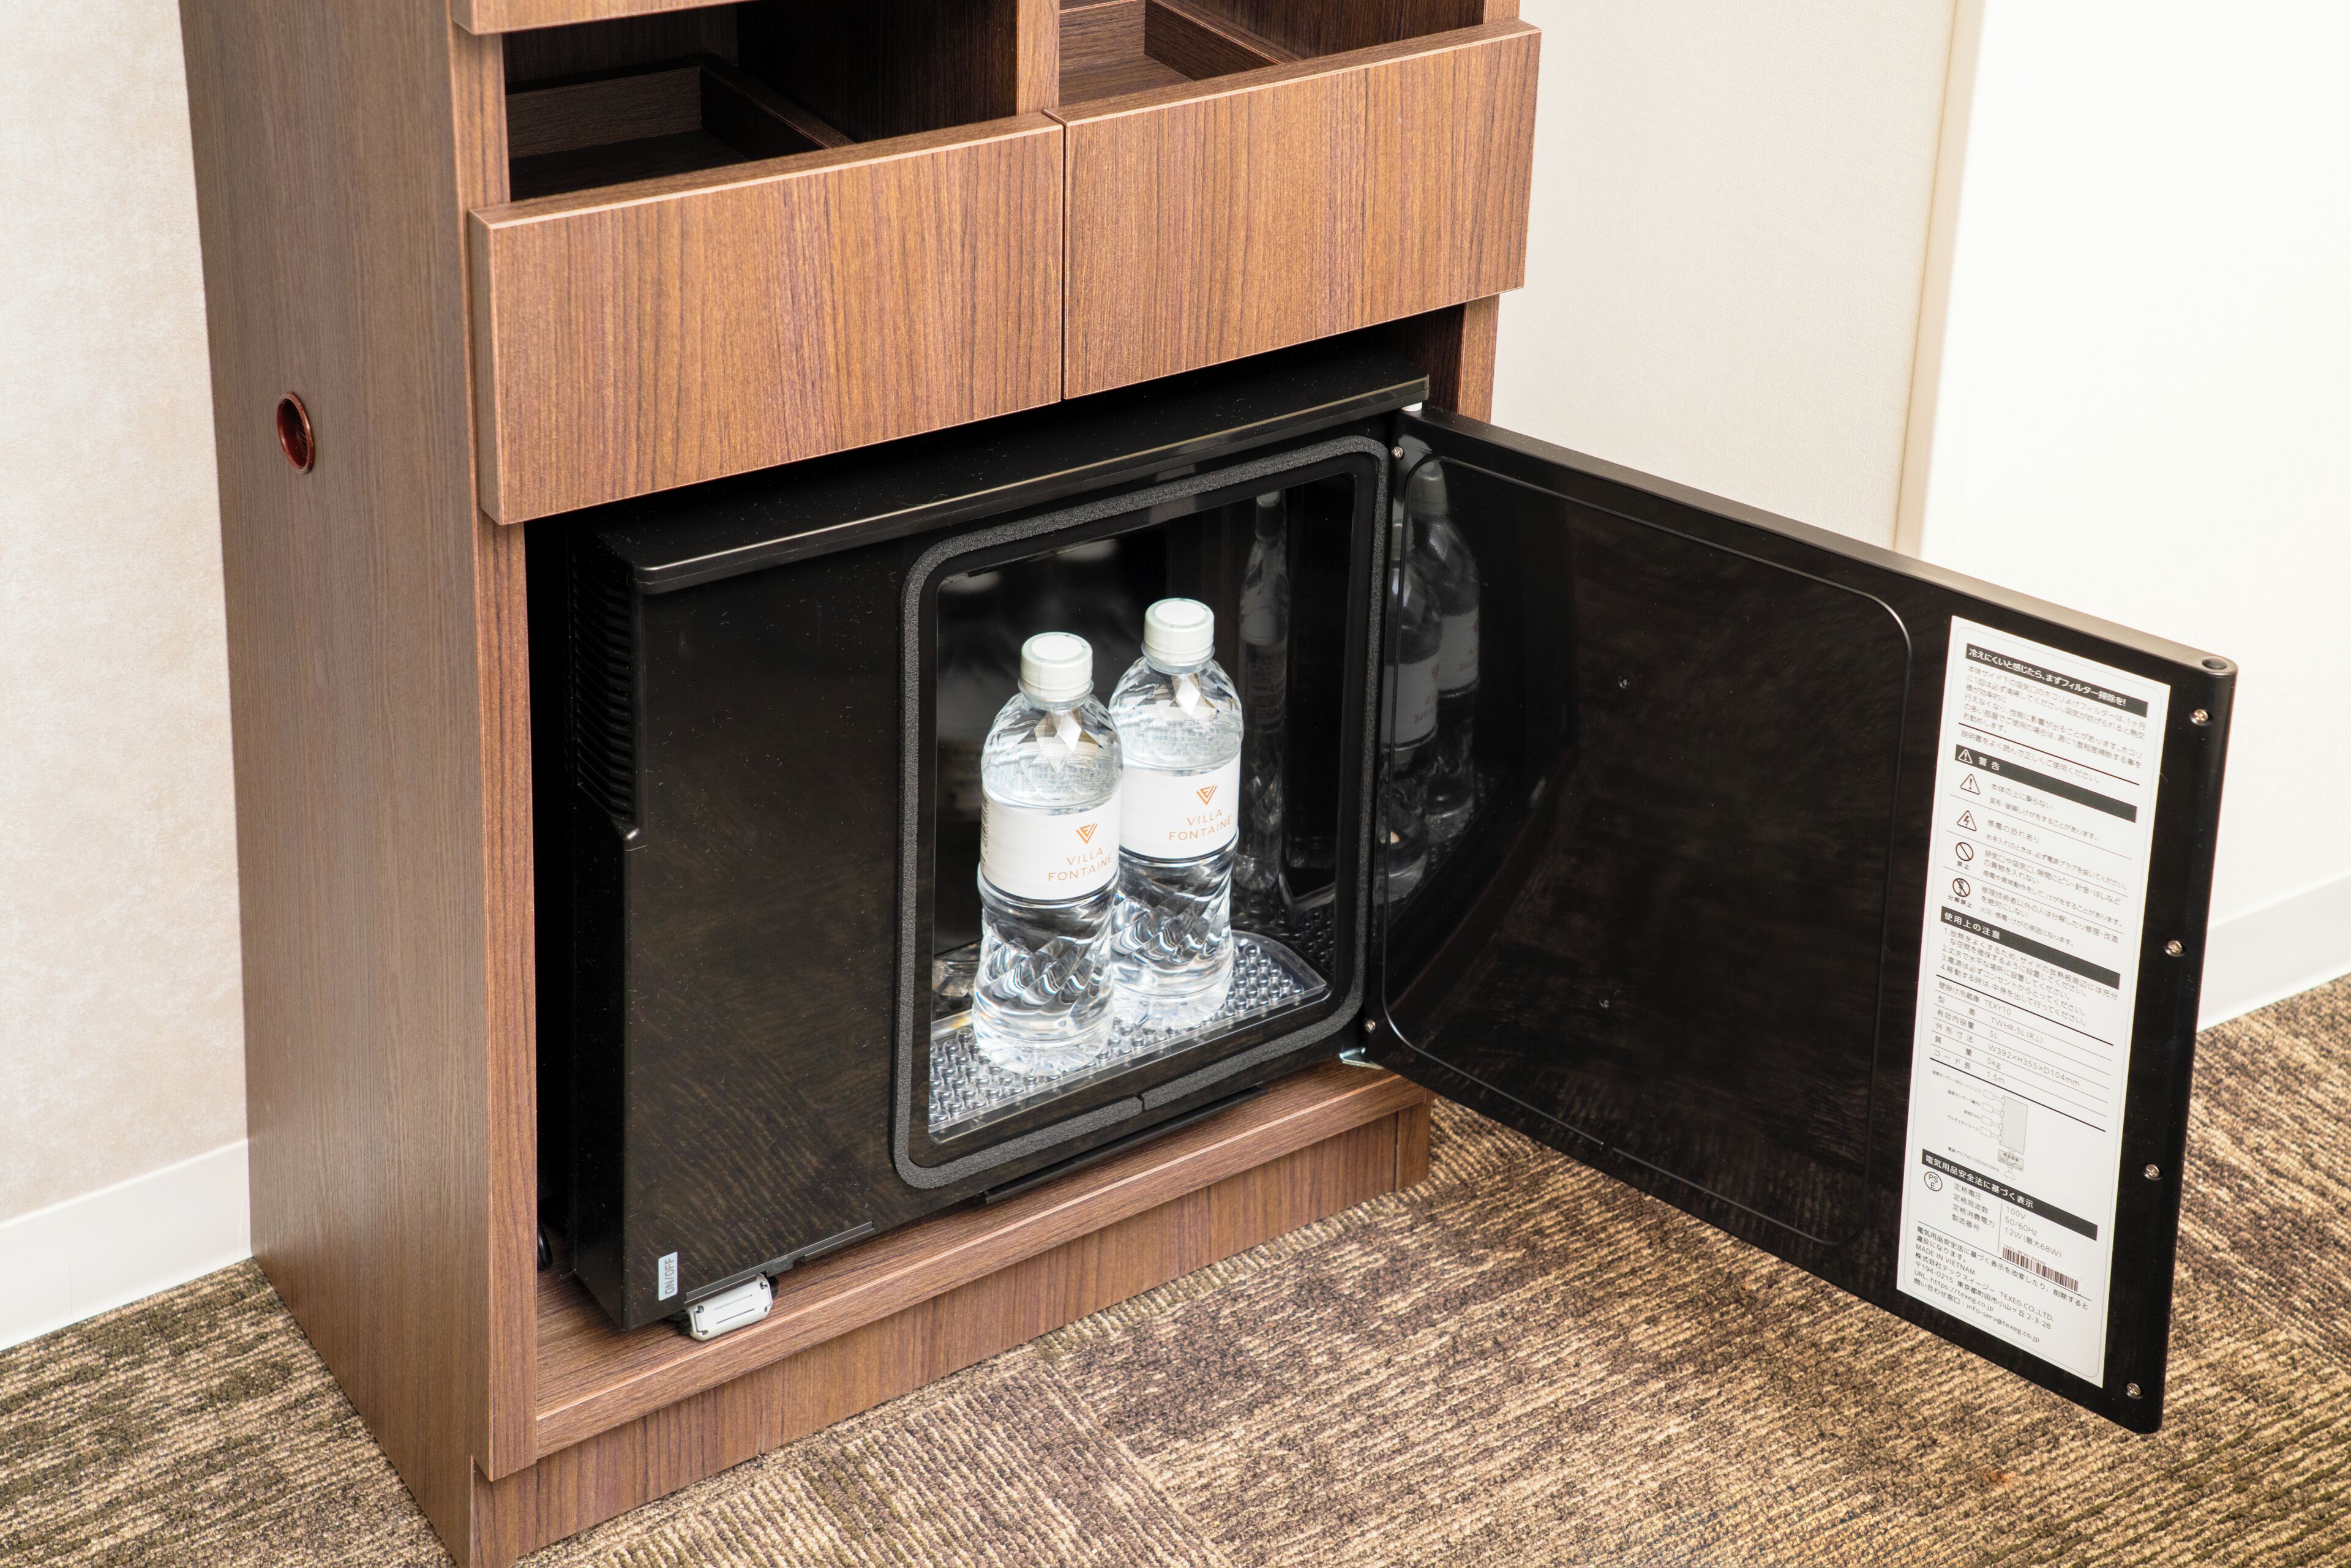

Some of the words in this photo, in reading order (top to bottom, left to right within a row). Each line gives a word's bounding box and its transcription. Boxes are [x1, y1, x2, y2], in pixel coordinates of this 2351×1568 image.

[1169, 814, 1232, 841] FONTAINE
[1187, 809, 1222, 825] VILLA
[1048, 852, 1112, 881] FONTAINE
[1067, 847, 1103, 865] VILLA
[1944, 912, 2000, 939] 使用上の注意
[1984, 999, 2011, 1015] TEXY10
[1937, 1009, 1974, 1029] 有効内容量
[1989, 1030, 1998, 1039] 5L
[1987, 1057, 2001, 1070] 5kg
[1987, 1071, 2004, 1084] 1.5m
[1925, 1155, 2033, 1208] 電気用品安全法に基づく表示
[1953, 1193, 1988, 1214] 定格周波数
[2004, 1216, 2037, 1236] 50/60Hz
[1954, 1183, 1981, 1200] 定格電圧
[2006, 1206, 2026, 1219] 100V
[1952, 1203, 1994, 1228] 定格消費電力
[1952, 1214, 1979, 1231] 製造番号
[1915, 1244, 1934, 1256] MADE
[1945, 1257, 1975, 1275] VIETNAM
[1916, 1235, 1965, 1262] 違反になります。
[665, 1259, 675, 1294] ON/OFF
[1930, 1277, 1993, 1311] https://texeg.co.jp
[2000, 1291, 2022, 1306] TEXEG
[2027, 1313, 2050, 1329] 2-3-28
